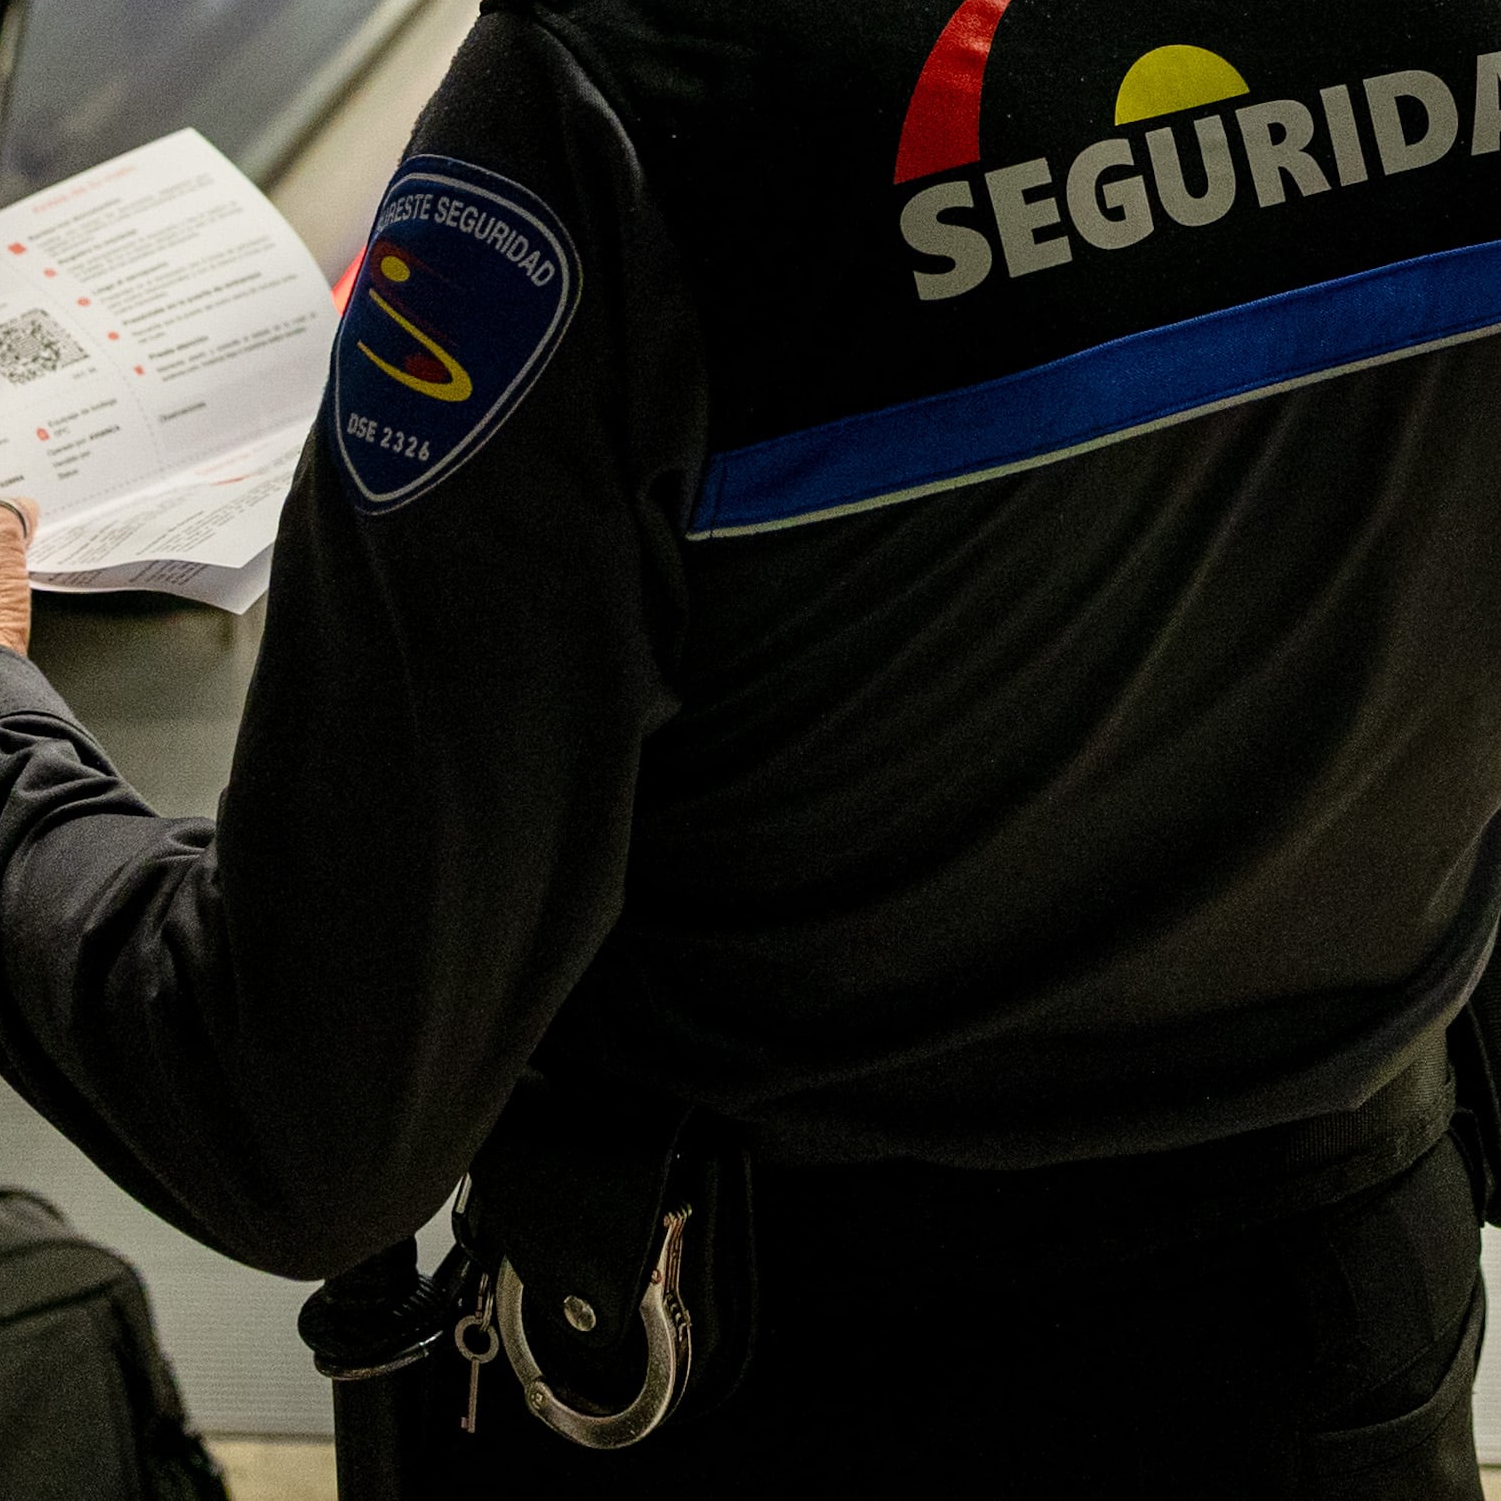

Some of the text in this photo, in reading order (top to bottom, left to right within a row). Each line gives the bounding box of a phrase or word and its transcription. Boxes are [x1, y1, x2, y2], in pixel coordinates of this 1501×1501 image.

[434, 196, 556, 287] SEGURIDAD
[347, 412, 430, 461] DSE 2326
